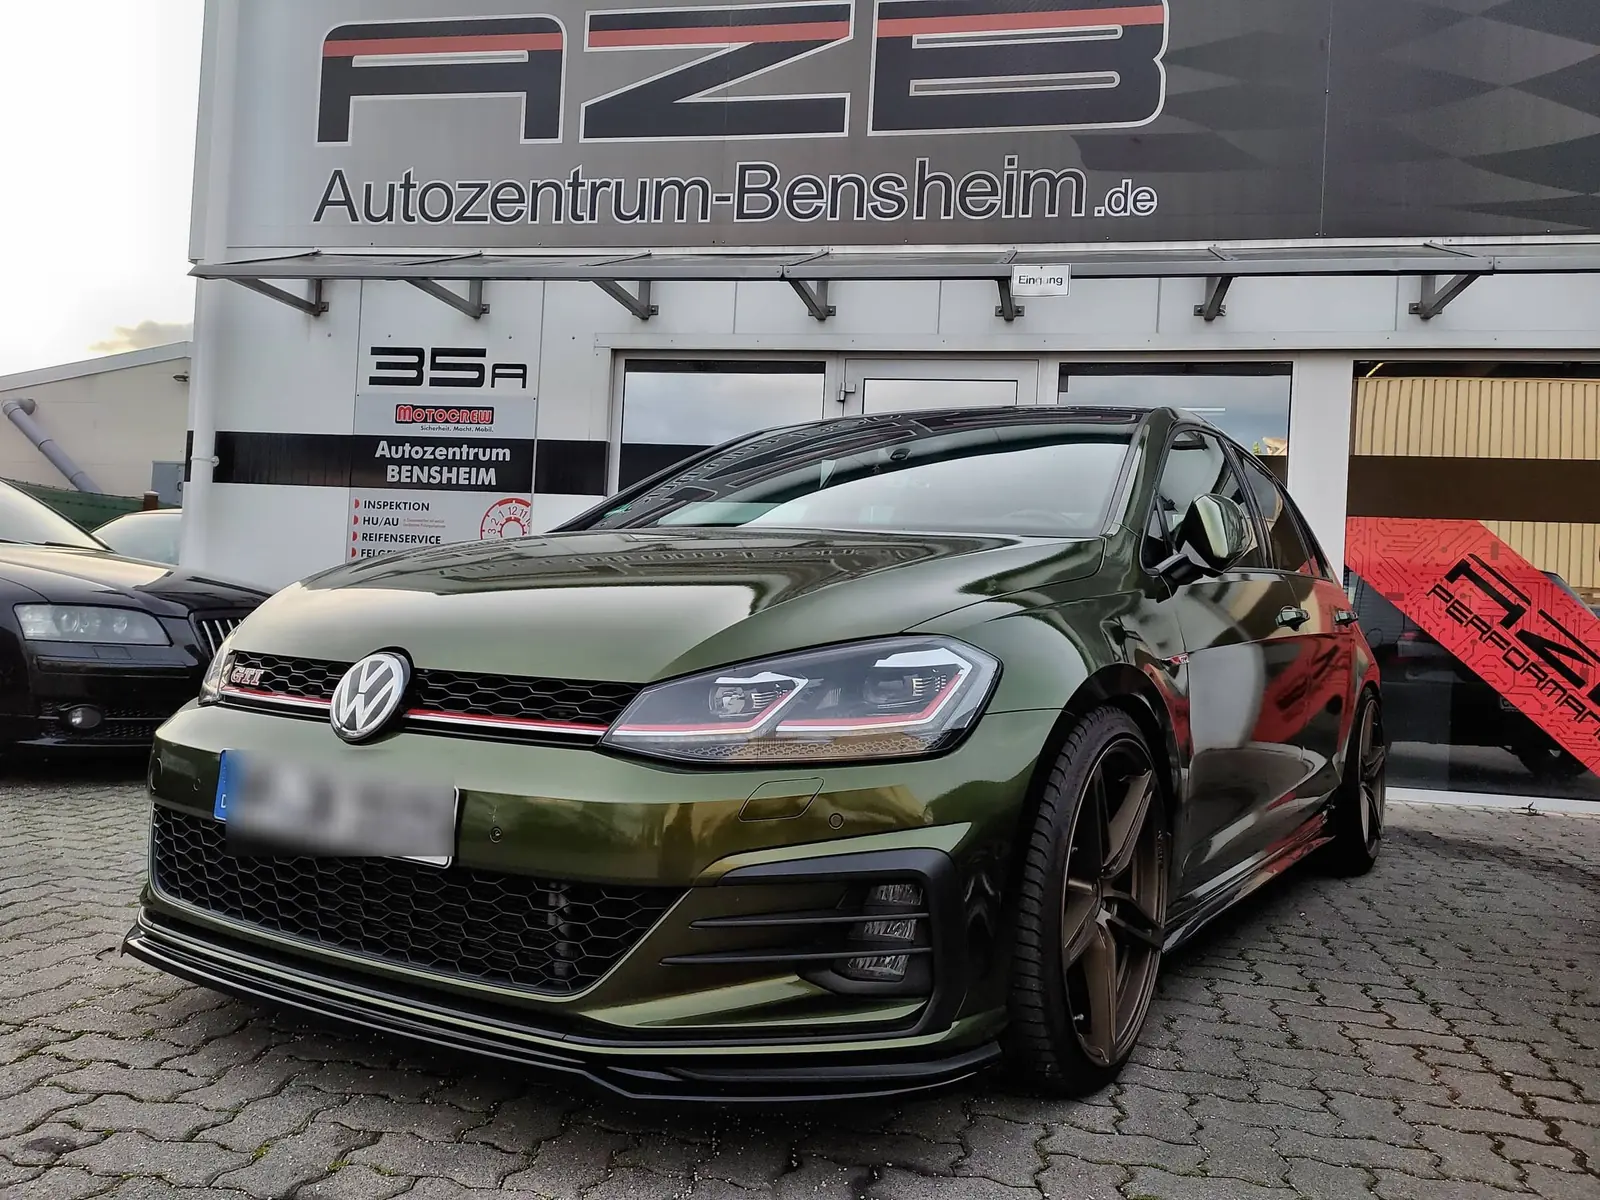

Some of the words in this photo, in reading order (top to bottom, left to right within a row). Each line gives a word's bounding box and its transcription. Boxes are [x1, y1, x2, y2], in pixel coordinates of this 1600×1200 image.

[315, 0, 1169, 144] AZB
[369, 347, 527, 388] 35A
[396, 404, 493, 424] MOTOCREW
[375, 440, 511, 462] Autozentrum
[386, 464, 497, 486] BENSHEIM
[363, 500, 430, 511] INSPEKTION
[508, 506, 518, 516] 12
[519, 508, 528, 519] 11
[362, 516, 400, 527] HU/AU
[490, 517, 500, 526] 2
[498, 510, 505, 518] 1
[361, 532, 441, 545] REIFENSERVICE
[1426, 583, 1600, 741] PERFORMAN
[231, 665, 264, 686] GTI
